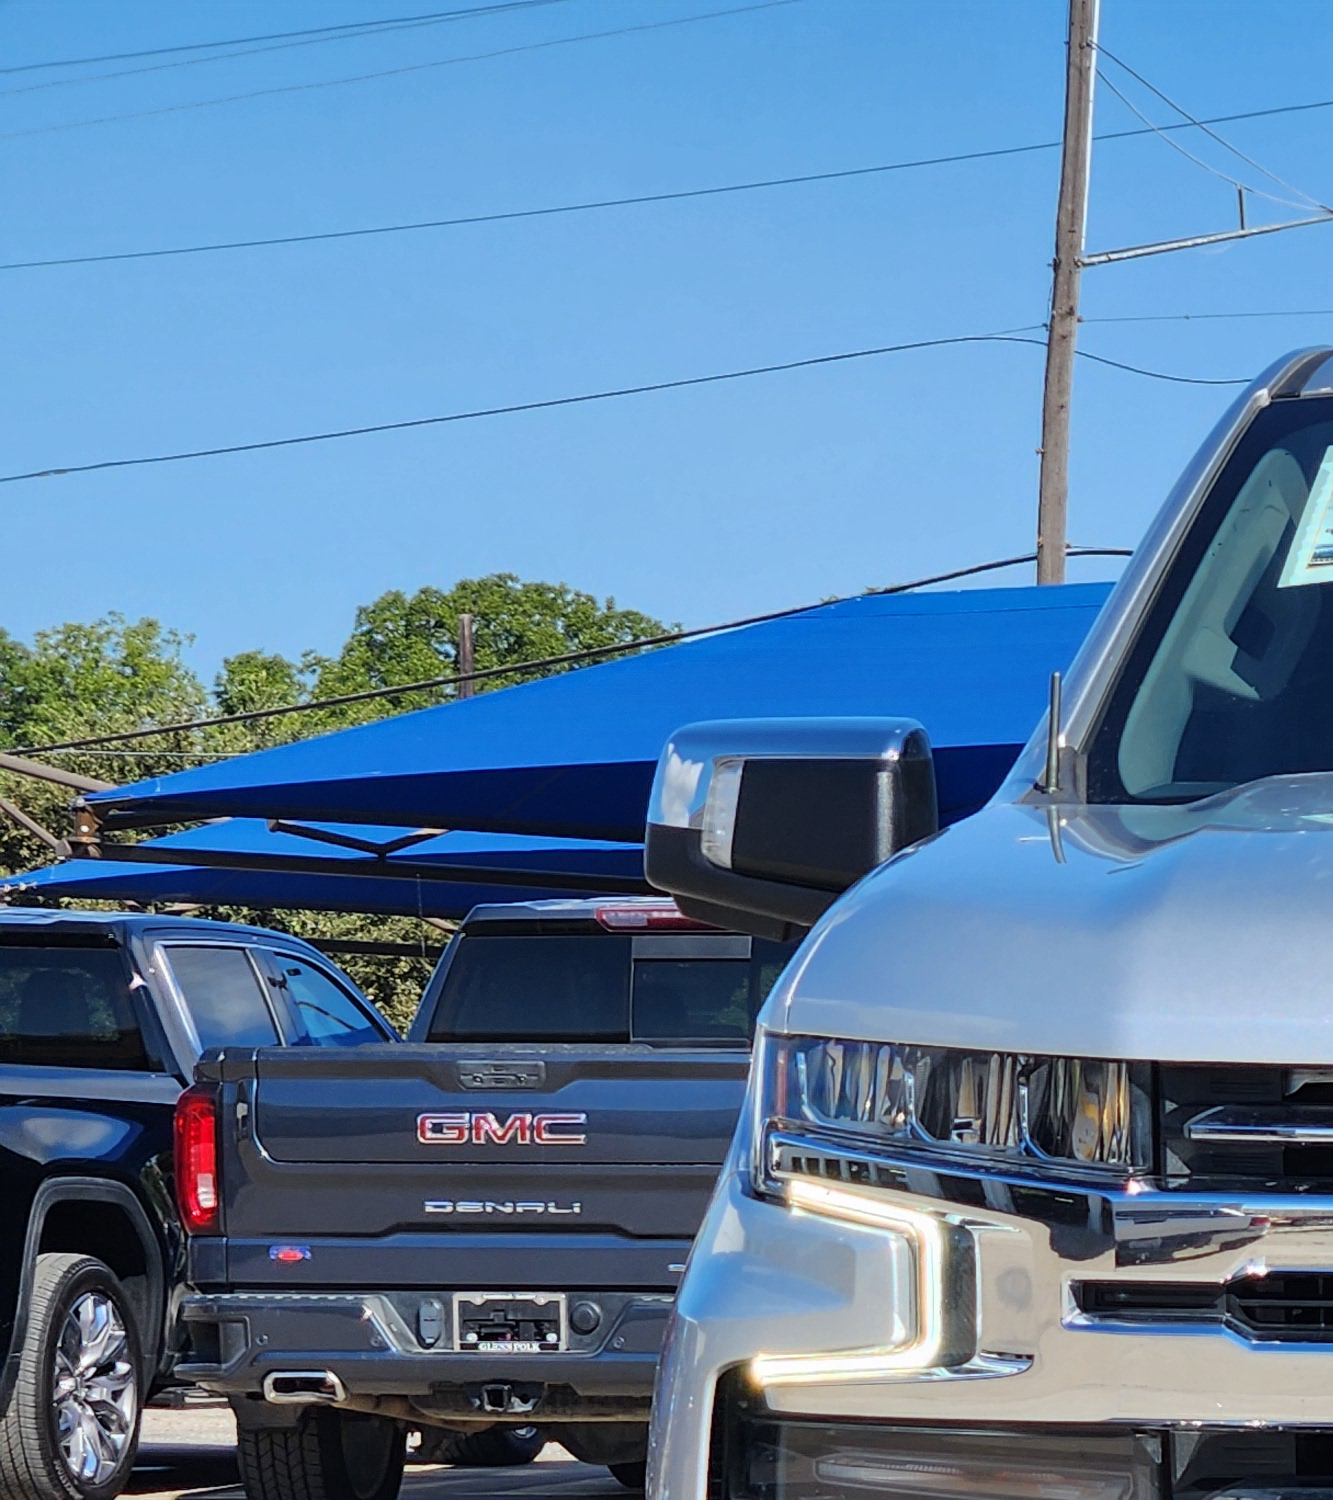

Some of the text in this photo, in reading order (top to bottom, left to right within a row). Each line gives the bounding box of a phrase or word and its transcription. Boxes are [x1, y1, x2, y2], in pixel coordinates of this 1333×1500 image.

[417, 1113, 587, 1145] GMC
[424, 1201, 582, 1214] DENALI
[513, 1342, 541, 1351] POLK
